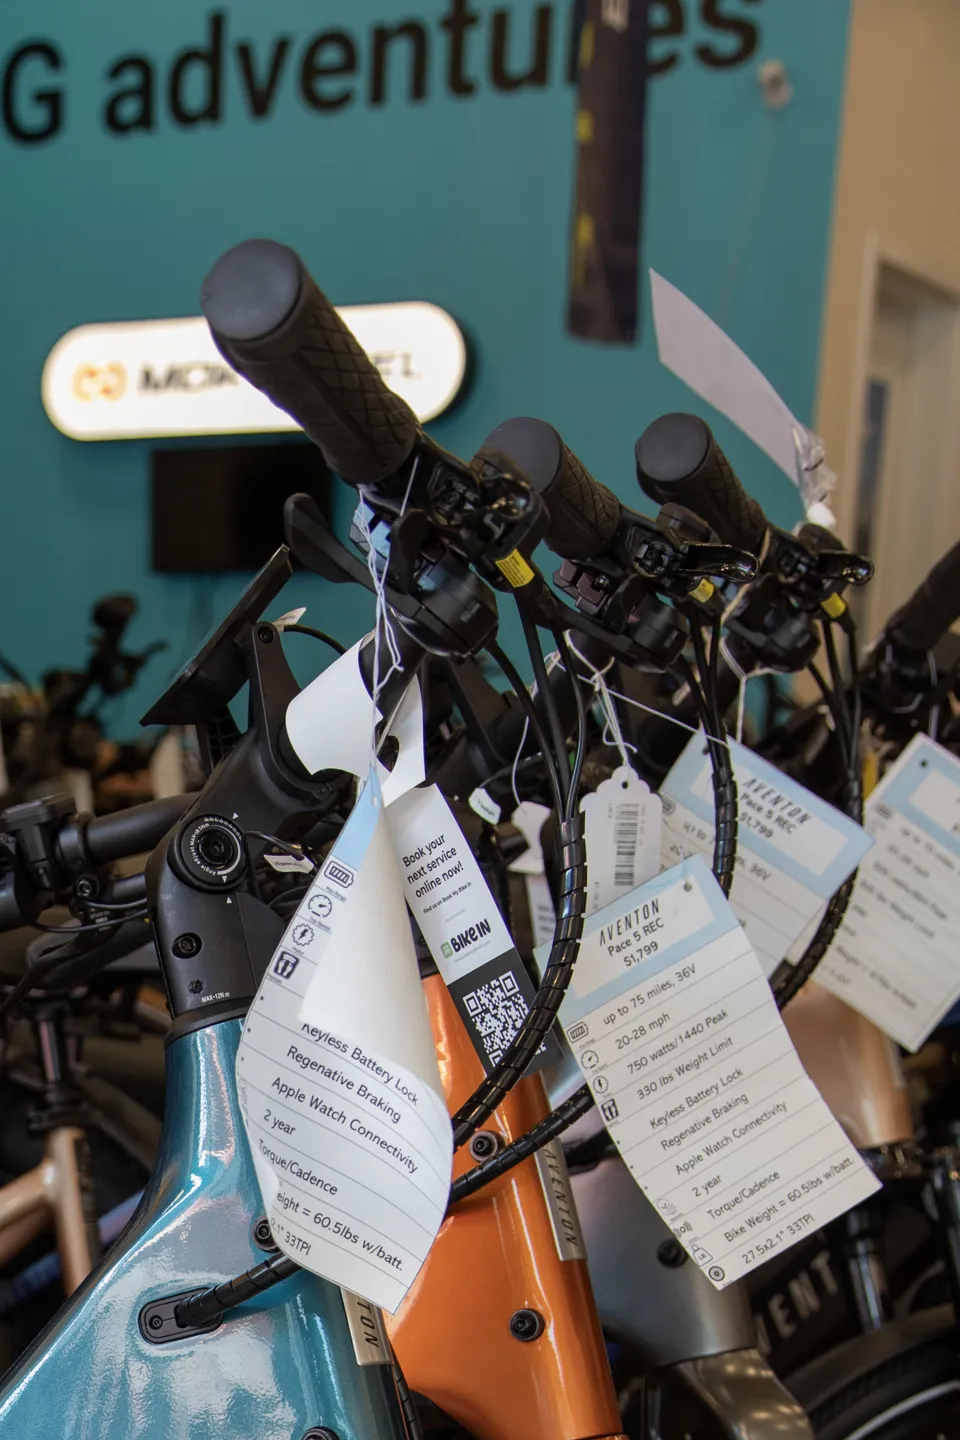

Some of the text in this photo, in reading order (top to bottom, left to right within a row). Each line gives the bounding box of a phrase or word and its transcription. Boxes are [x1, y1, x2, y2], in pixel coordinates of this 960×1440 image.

[740, 793, 797, 834] Pace 5 REC
[742, 778, 812, 824] AVENTON
[402, 834, 445, 867] Book your
[407, 847, 457, 884] next service
[415, 861, 464, 898] online now!
[423, 905, 432, 914] Find
[442, 894, 452, 903] Book
[452, 890, 459, 898] My
[458, 884, 467, 894] Bike
[475, 919, 491, 938] IN
[599, 898, 660, 946] AVENTON
[607, 918, 664, 957] Pace 5 REC
[623, 941, 659, 968] $1,799
[603, 964, 697, 1027] up to 75 miles, 36V
[614, 1025, 647, 1050] 20-28
[648, 1012, 670, 1032] mph
[627, 1056, 648, 1075] 750
[649, 1023, 705, 1061] watts/1440
[705, 1008, 729, 1029] Peak
[286, 1045, 402, 1125] Regenative Braking
[350, 1047, 394, 1084] Battery
[394, 1078, 418, 1107] Lock
[637, 1036, 734, 1100] 330 lbs Weight Limit
[263, 1109, 296, 1136] 2 year
[649, 1067, 744, 1130] Keyless Battery Lock
[660, 1093, 750, 1151] Regenative Braking
[271, 1076, 418, 1174] Apple Watch Connectivity
[675, 1101, 788, 1175] Apple Watch Connectivity
[258, 1138, 338, 1196] Torque/Cadence
[691, 1175, 722, 1198] 2 year
[544, 1148, 578, 1246] AVENTON
[706, 1171, 781, 1221] Torque/Cadence
[723, 1224, 747, 1243] Bike
[746, 1203, 779, 1231] Weight
[787, 1176, 823, 1203] 60.5lbs
[823, 1156, 855, 1182] w/batt.
[277, 1191, 301, 1214] eight
[313, 1212, 360, 1244] 60.5lbs
[362, 1239, 403, 1272] w/batt.
[284, 1230, 312, 1256] 33TPI
[788, 1212, 815, 1236] 33TPI
